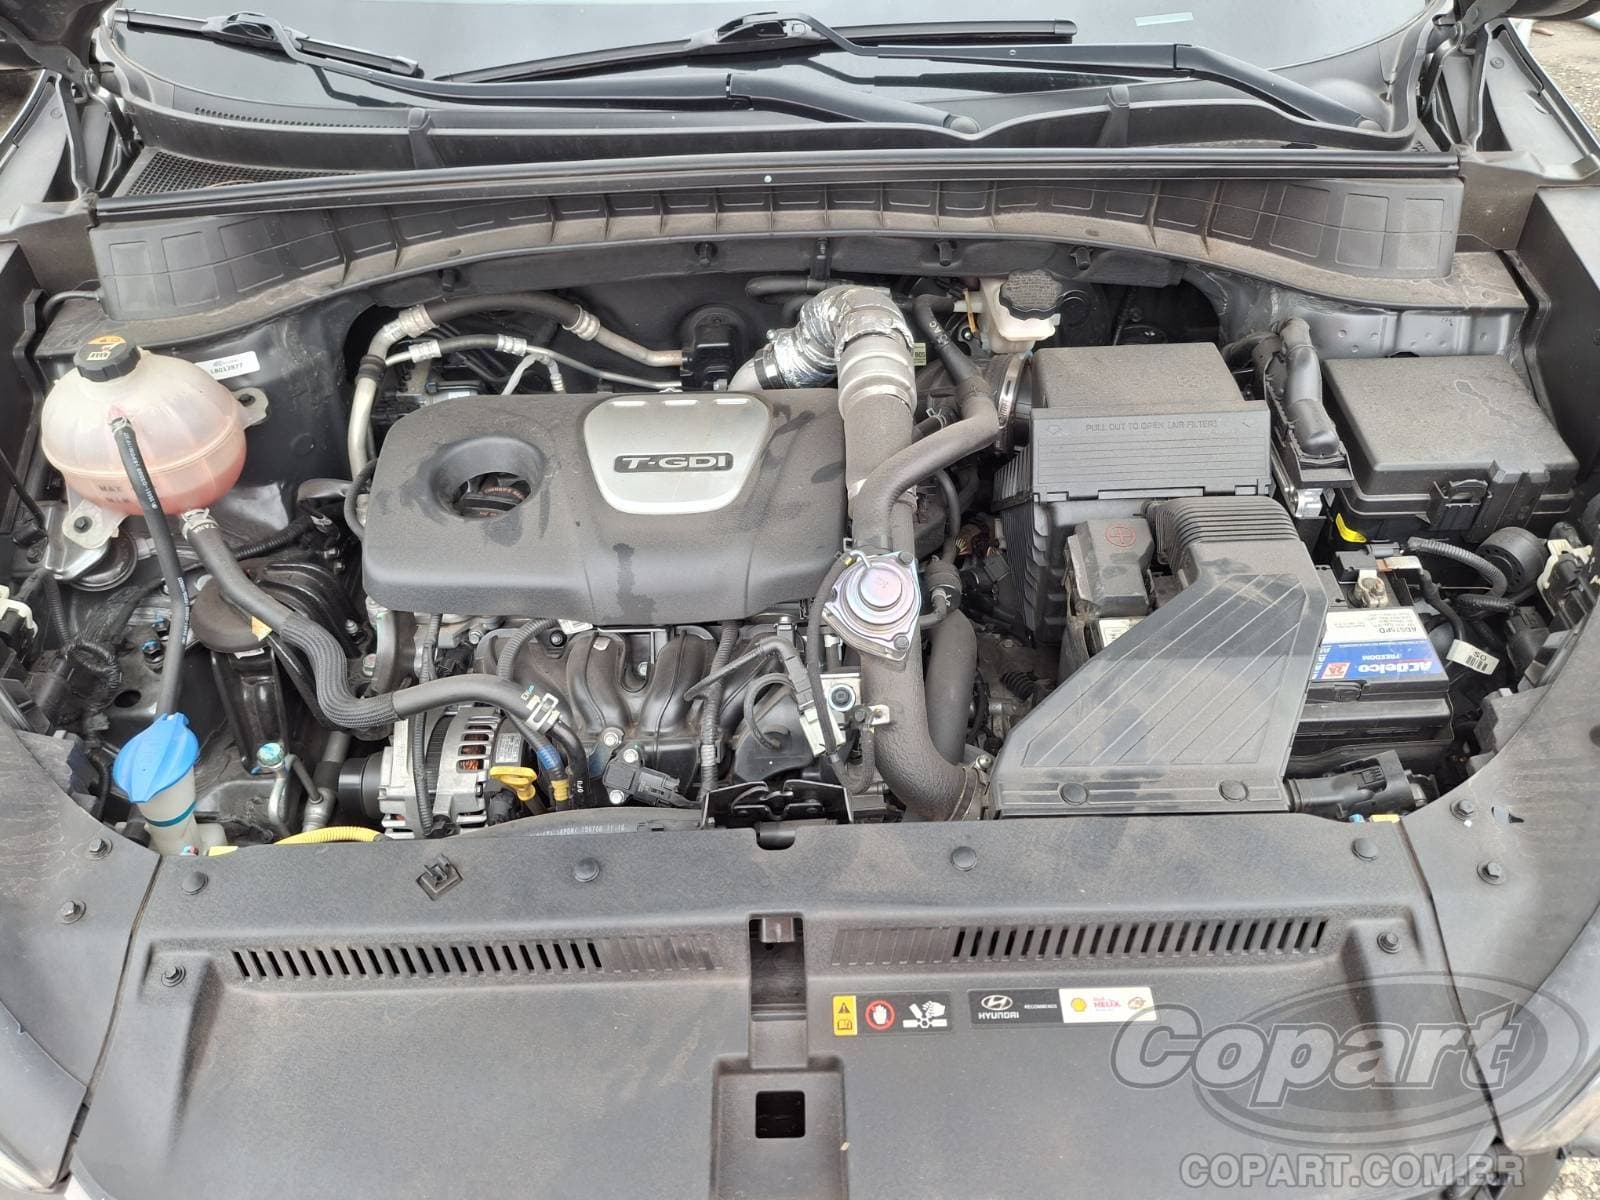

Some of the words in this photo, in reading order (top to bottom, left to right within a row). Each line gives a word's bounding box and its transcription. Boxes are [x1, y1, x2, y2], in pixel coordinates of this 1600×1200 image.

[1085, 423, 1106, 432] PULL
[1109, 422, 1125, 431] OUT
[1128, 422, 1139, 430] TO
[1141, 422, 1163, 430] OPEN
[622, 455, 727, 469] T-GDI
[978, 1011, 1019, 1019] HYUNDAI
